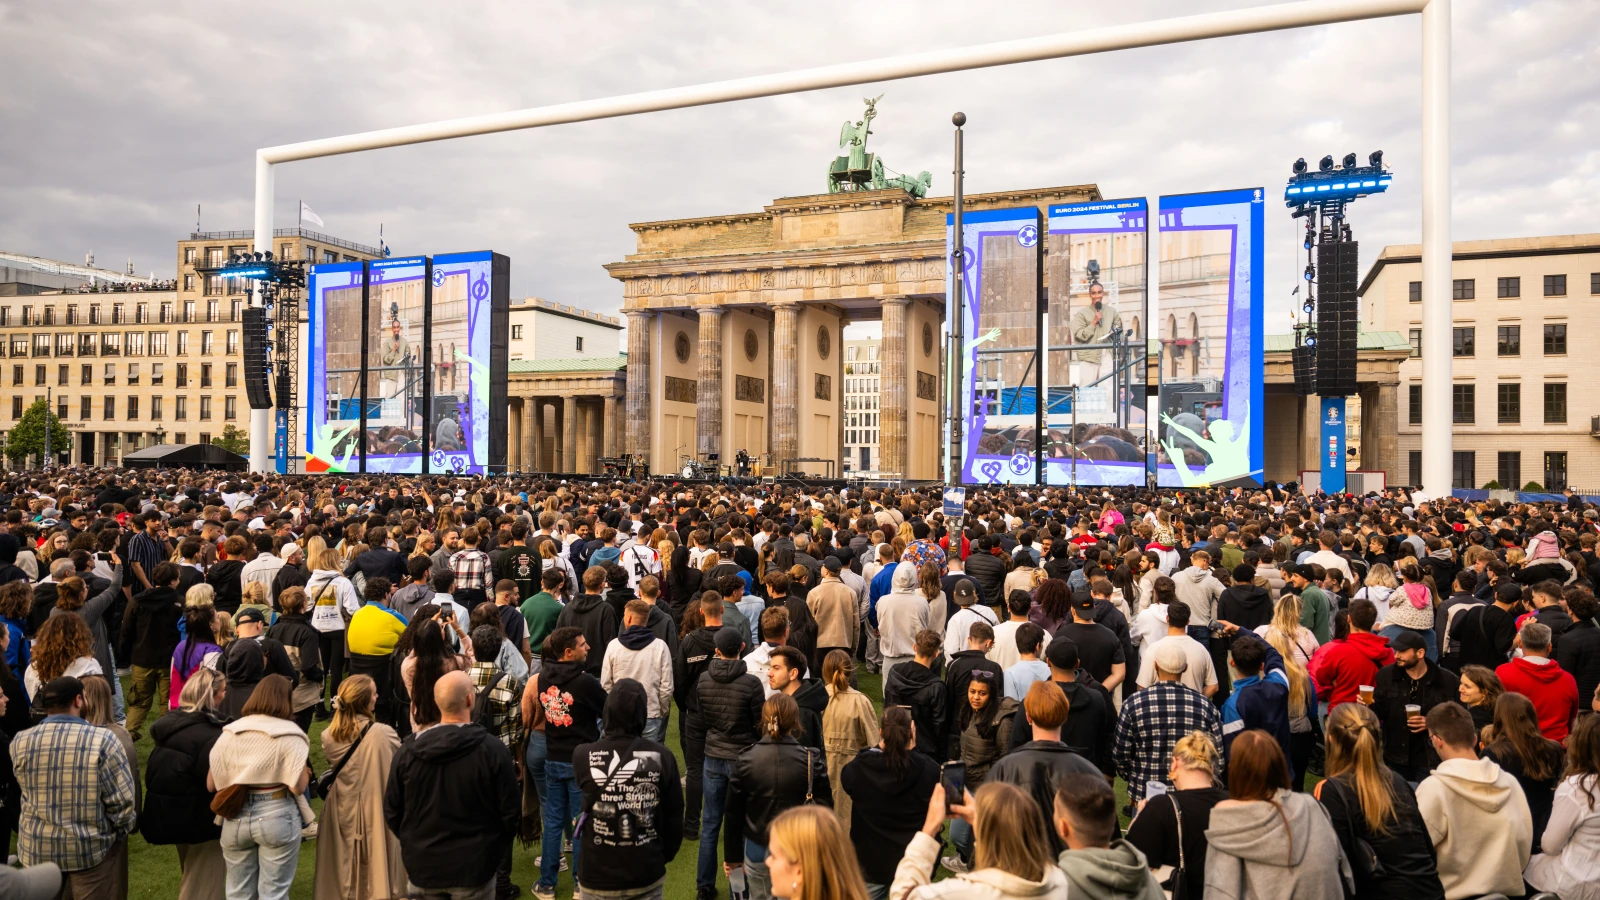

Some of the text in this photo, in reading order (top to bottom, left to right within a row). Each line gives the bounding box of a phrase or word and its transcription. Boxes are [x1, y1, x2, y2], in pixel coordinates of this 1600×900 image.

[617, 784, 634, 792] The
[601, 792, 655, 802] three Stripes
[617, 801, 640, 810] World
